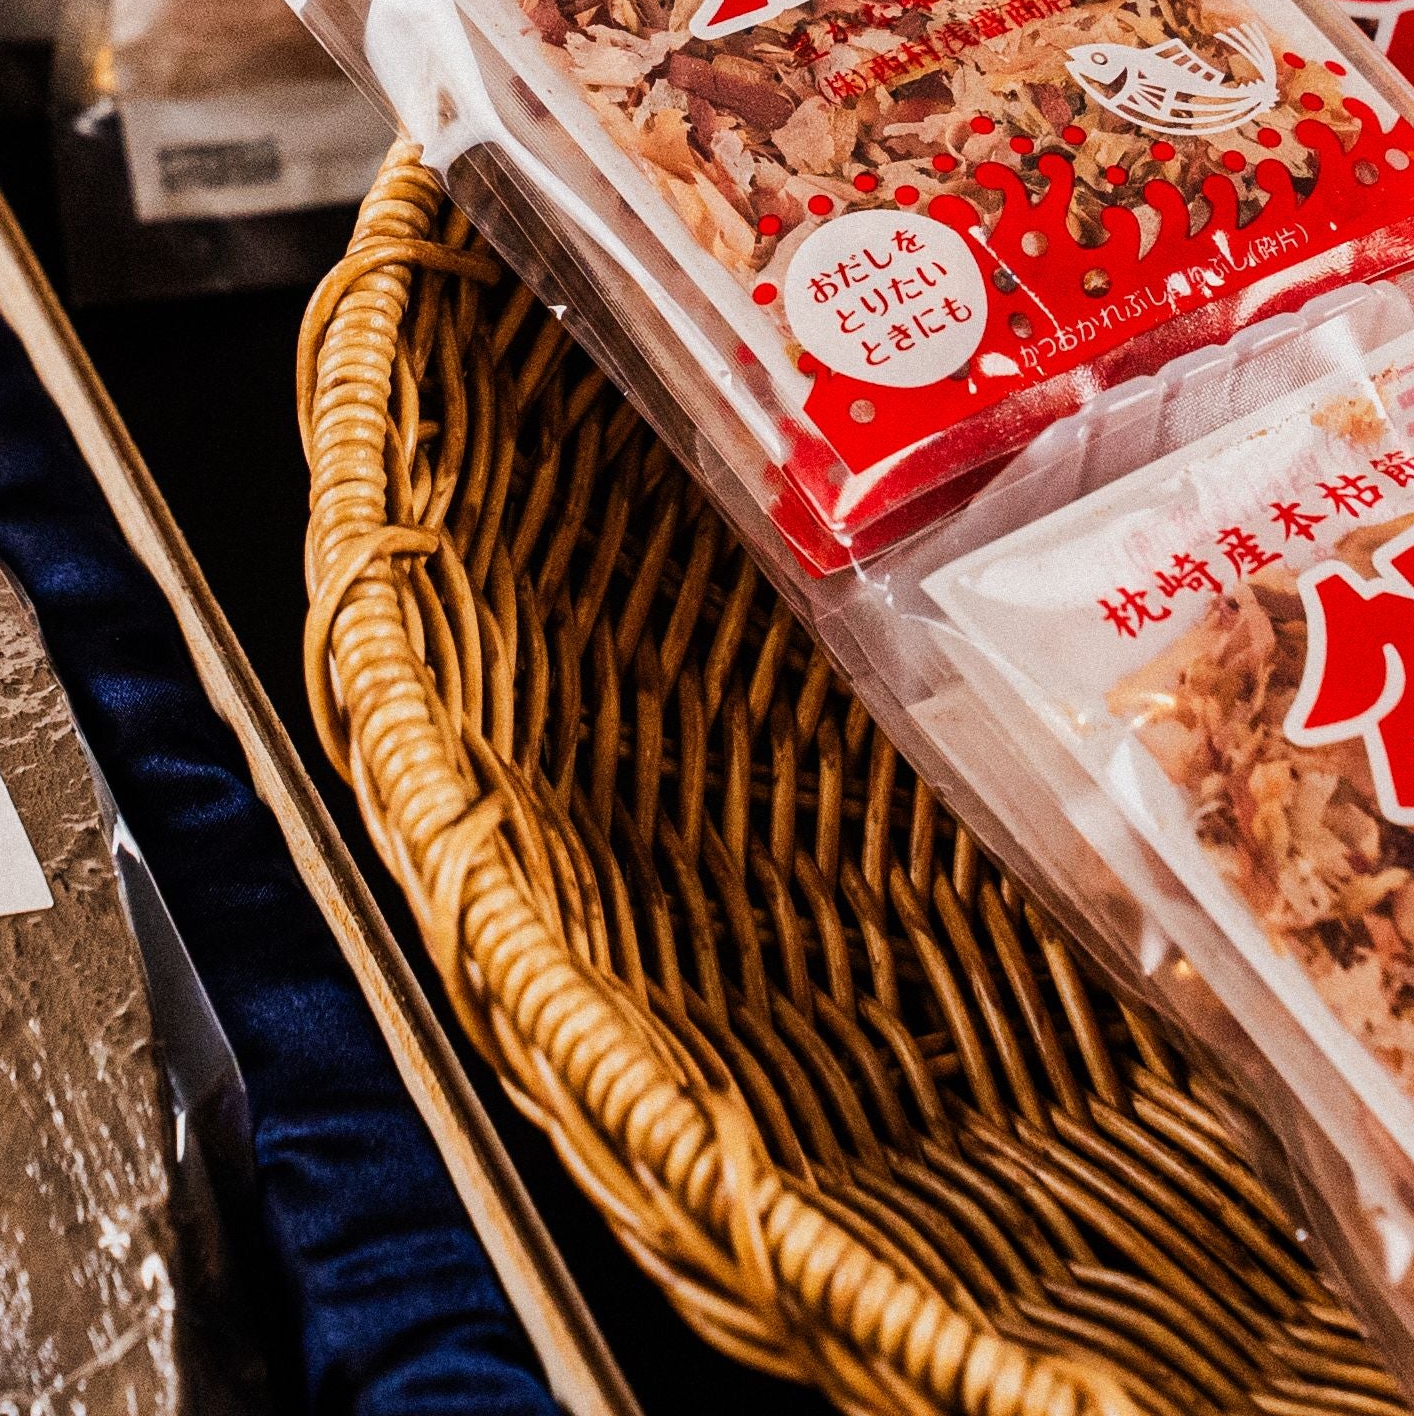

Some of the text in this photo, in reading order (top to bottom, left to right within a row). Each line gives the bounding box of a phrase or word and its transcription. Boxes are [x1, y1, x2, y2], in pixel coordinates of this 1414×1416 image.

[806, 227, 926, 302] おだしを
[836, 261, 949, 337] とりたい
[860, 295, 974, 367] ときにも
